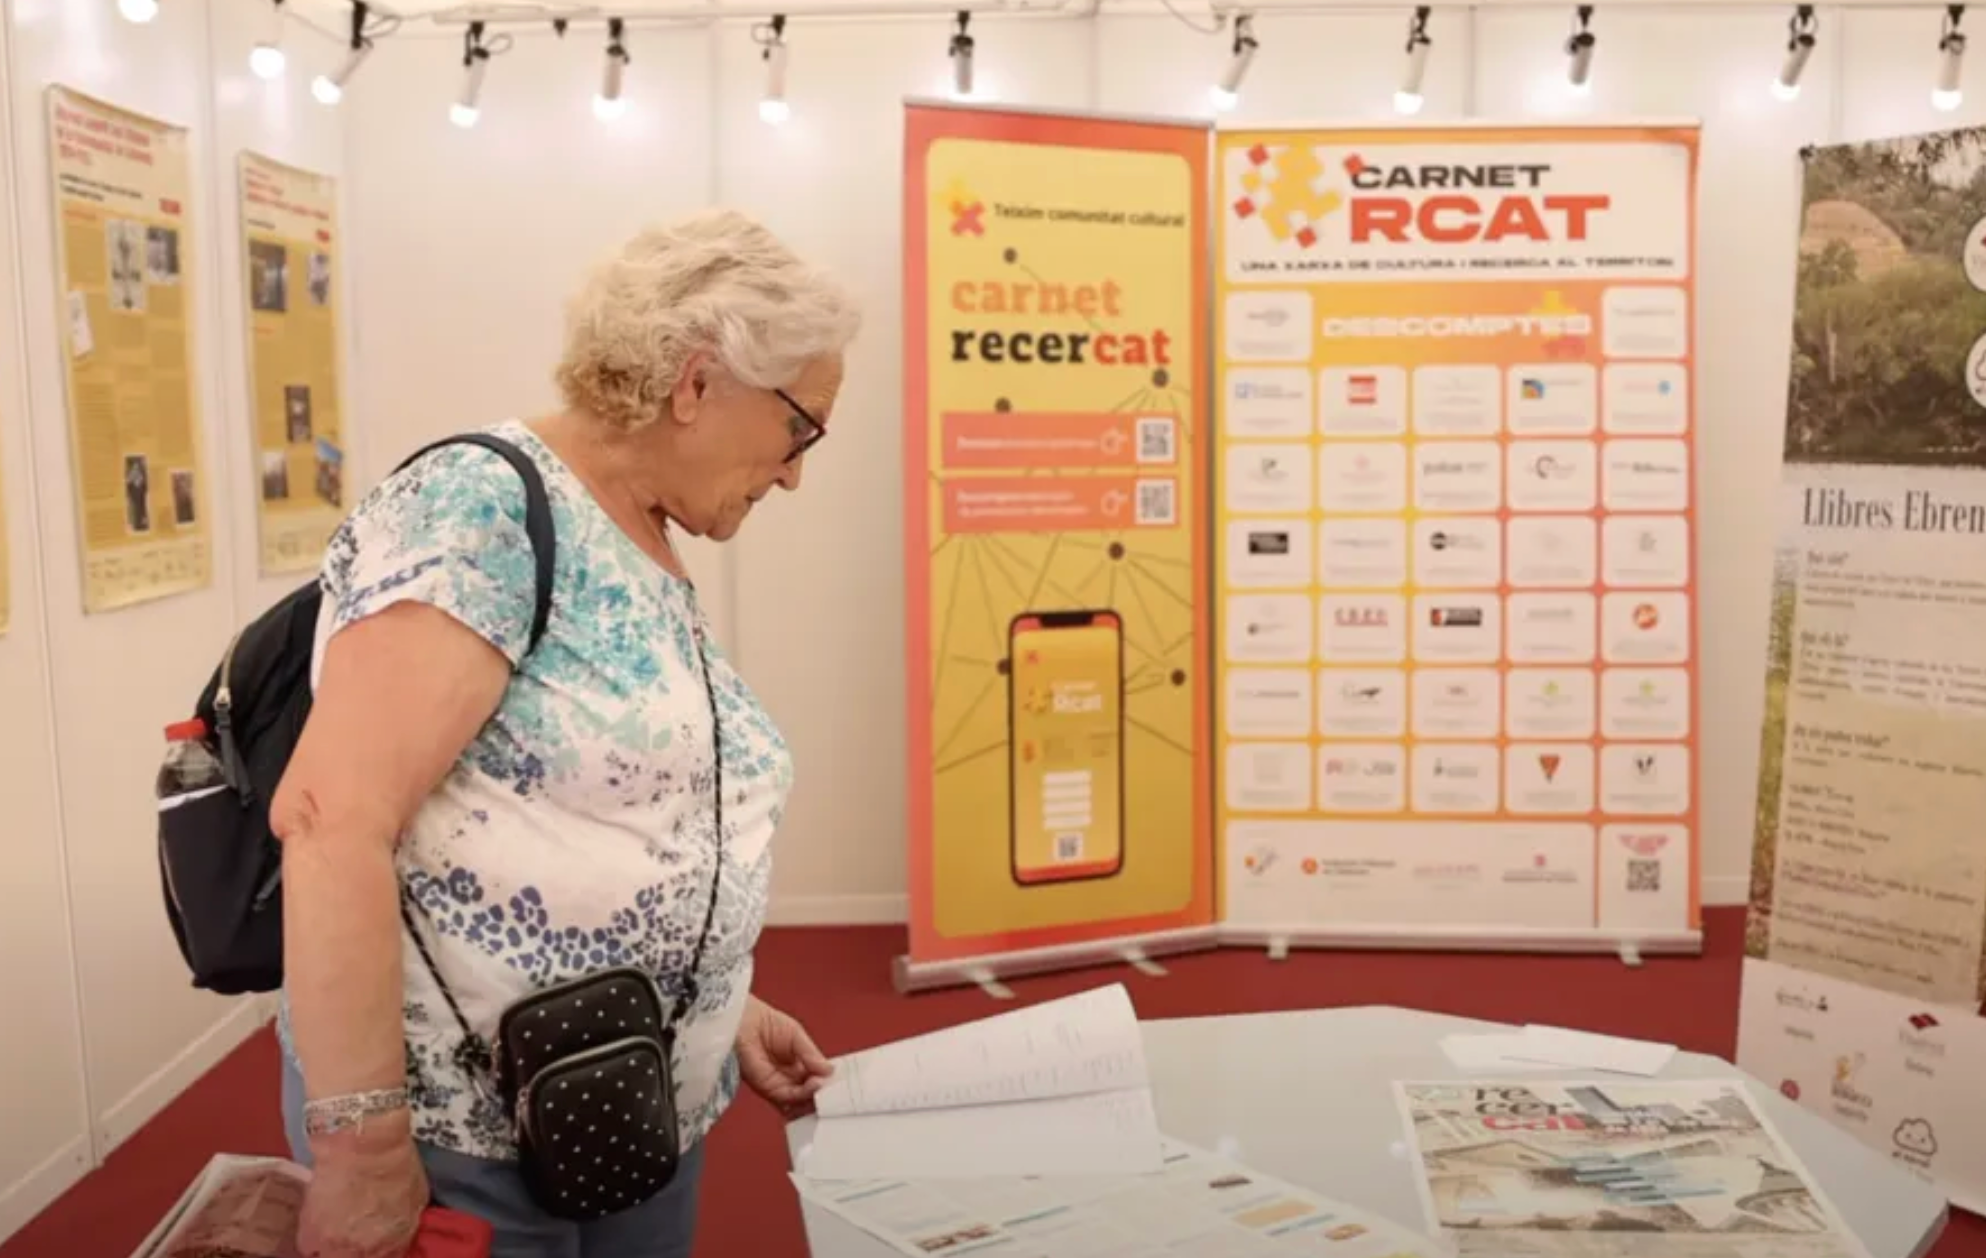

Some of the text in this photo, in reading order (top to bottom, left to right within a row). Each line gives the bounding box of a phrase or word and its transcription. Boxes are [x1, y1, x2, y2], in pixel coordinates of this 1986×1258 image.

[1351, 165, 1550, 189] CARNET
[994, 202, 1186, 228] Teixim comunitat cultural
[1350, 195, 1610, 243] RCAT
[1241, 260, 1277, 271] UNA
[1349, 259, 1370, 270] DE
[1376, 258, 1455, 270] CULTURA
[1470, 257, 1550, 268] RECERCA
[1557, 257, 1576, 268] AL
[952, 278, 1122, 317] carnet
[1322, 314, 1591, 338] DESCOMPTES
[951, 329, 1171, 365] recercat
[1803, 487, 1894, 529] Llibres
